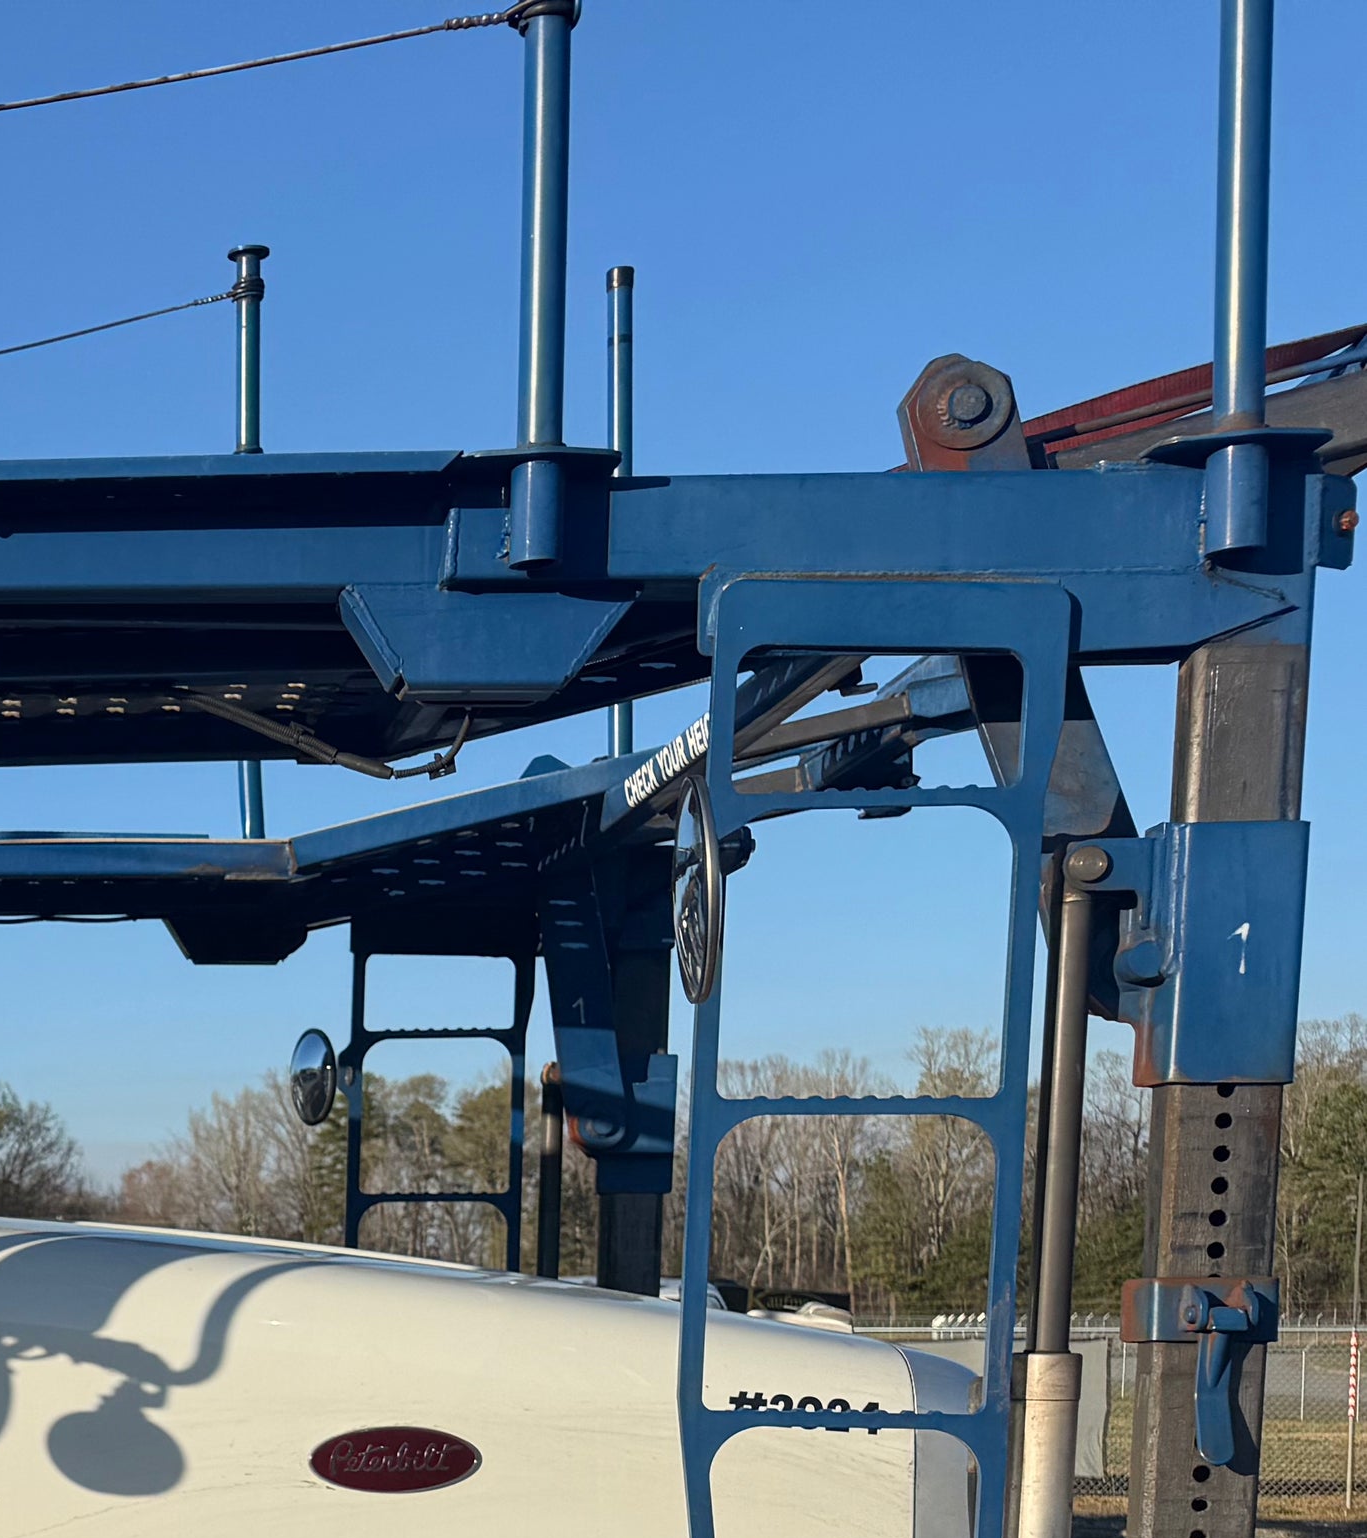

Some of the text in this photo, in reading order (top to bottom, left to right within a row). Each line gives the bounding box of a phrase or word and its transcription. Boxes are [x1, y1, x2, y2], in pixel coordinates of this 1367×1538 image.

[624, 757, 660, 808] CHECK
[655, 736, 689, 782] YOUR
[1227, 922, 1250, 975] 1
[330, 1440, 466, 1477] Peterbilt
